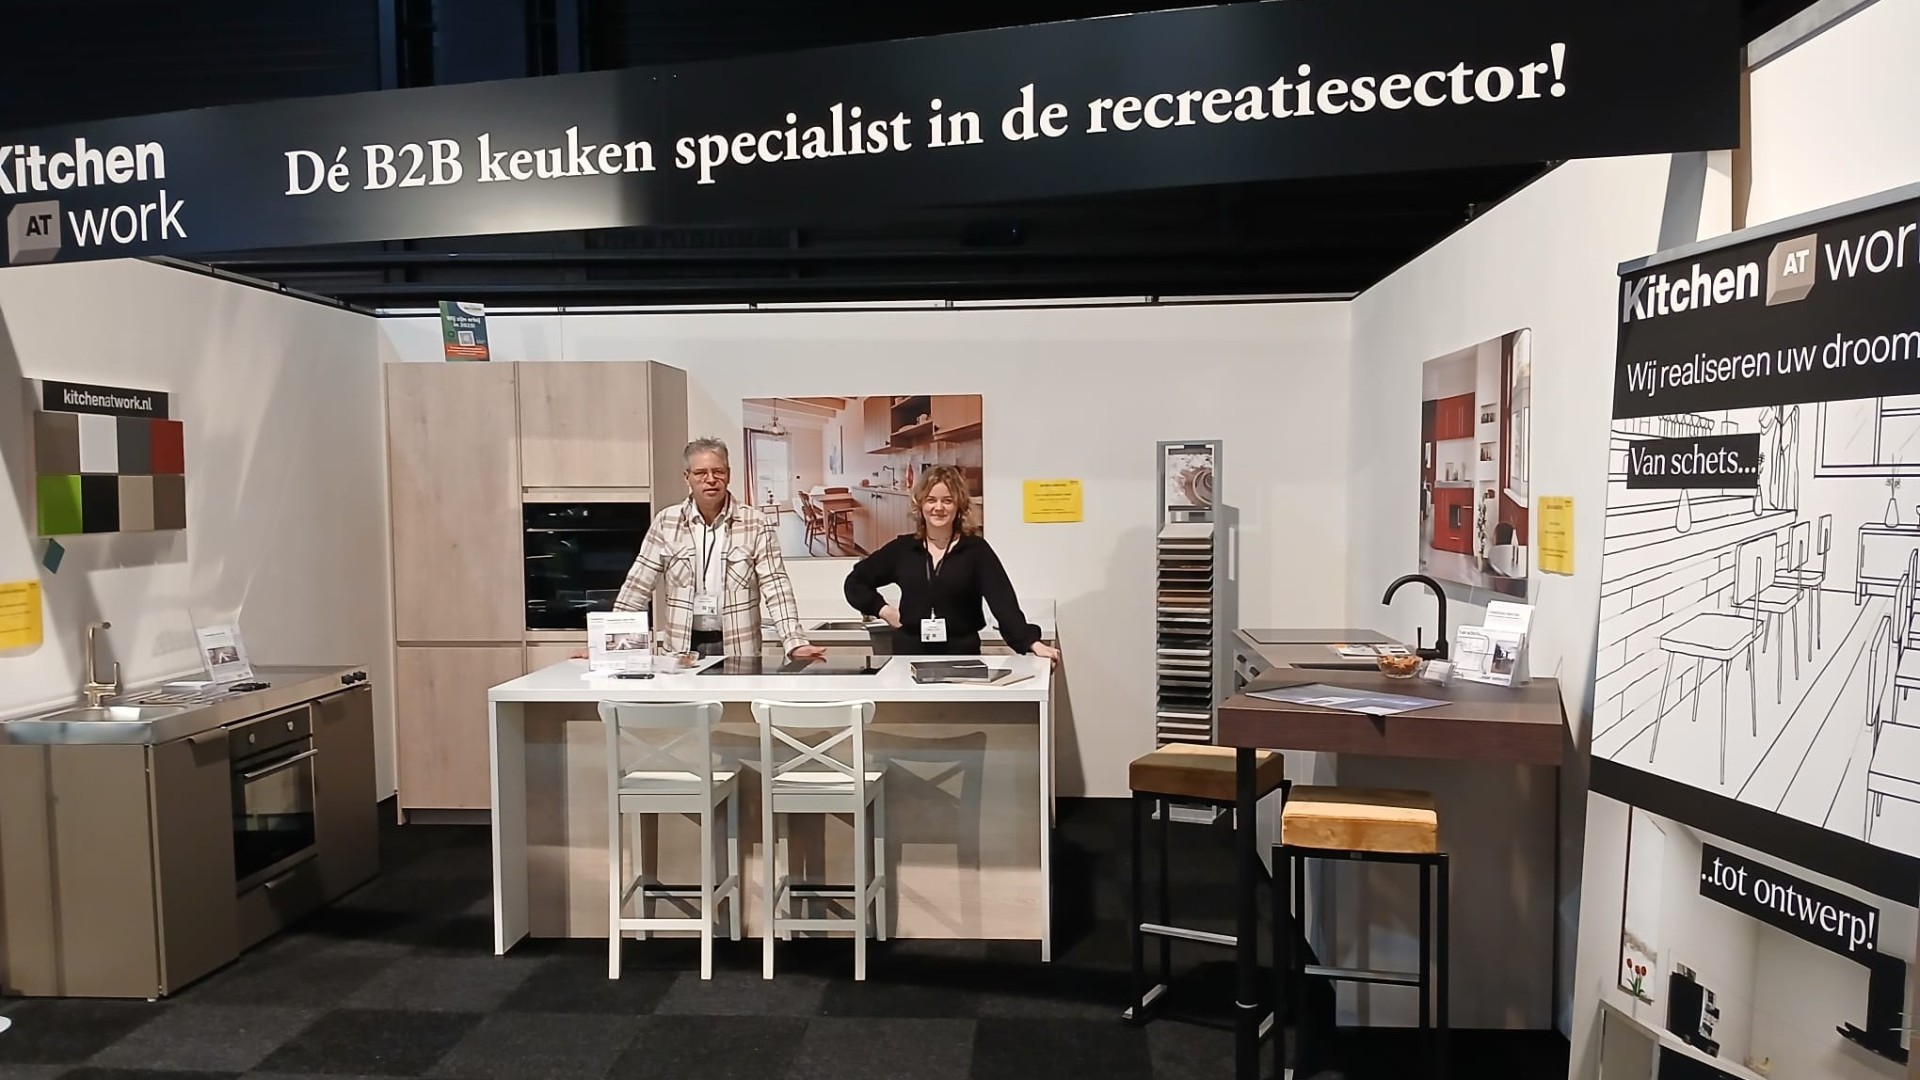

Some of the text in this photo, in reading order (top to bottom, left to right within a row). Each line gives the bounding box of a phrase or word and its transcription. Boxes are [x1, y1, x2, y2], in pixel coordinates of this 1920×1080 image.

[284, 42, 1568, 196] Dé B2B keuken specialist in de recreatiesector!
[0, 137, 166, 194] Kitchen
[26, 189, 188, 247] AT work
[1622, 221, 1920, 323] Kitchen AT wor
[63, 388, 153, 411] kitchenatwork.nl
[1627, 361, 1657, 397] Wij
[1660, 351, 1770, 388] realiseren
[1777, 345, 1816, 374] uw
[1630, 443, 1757, 476] Van schets...
[1753, 878, 1876, 951] ontwerp!
